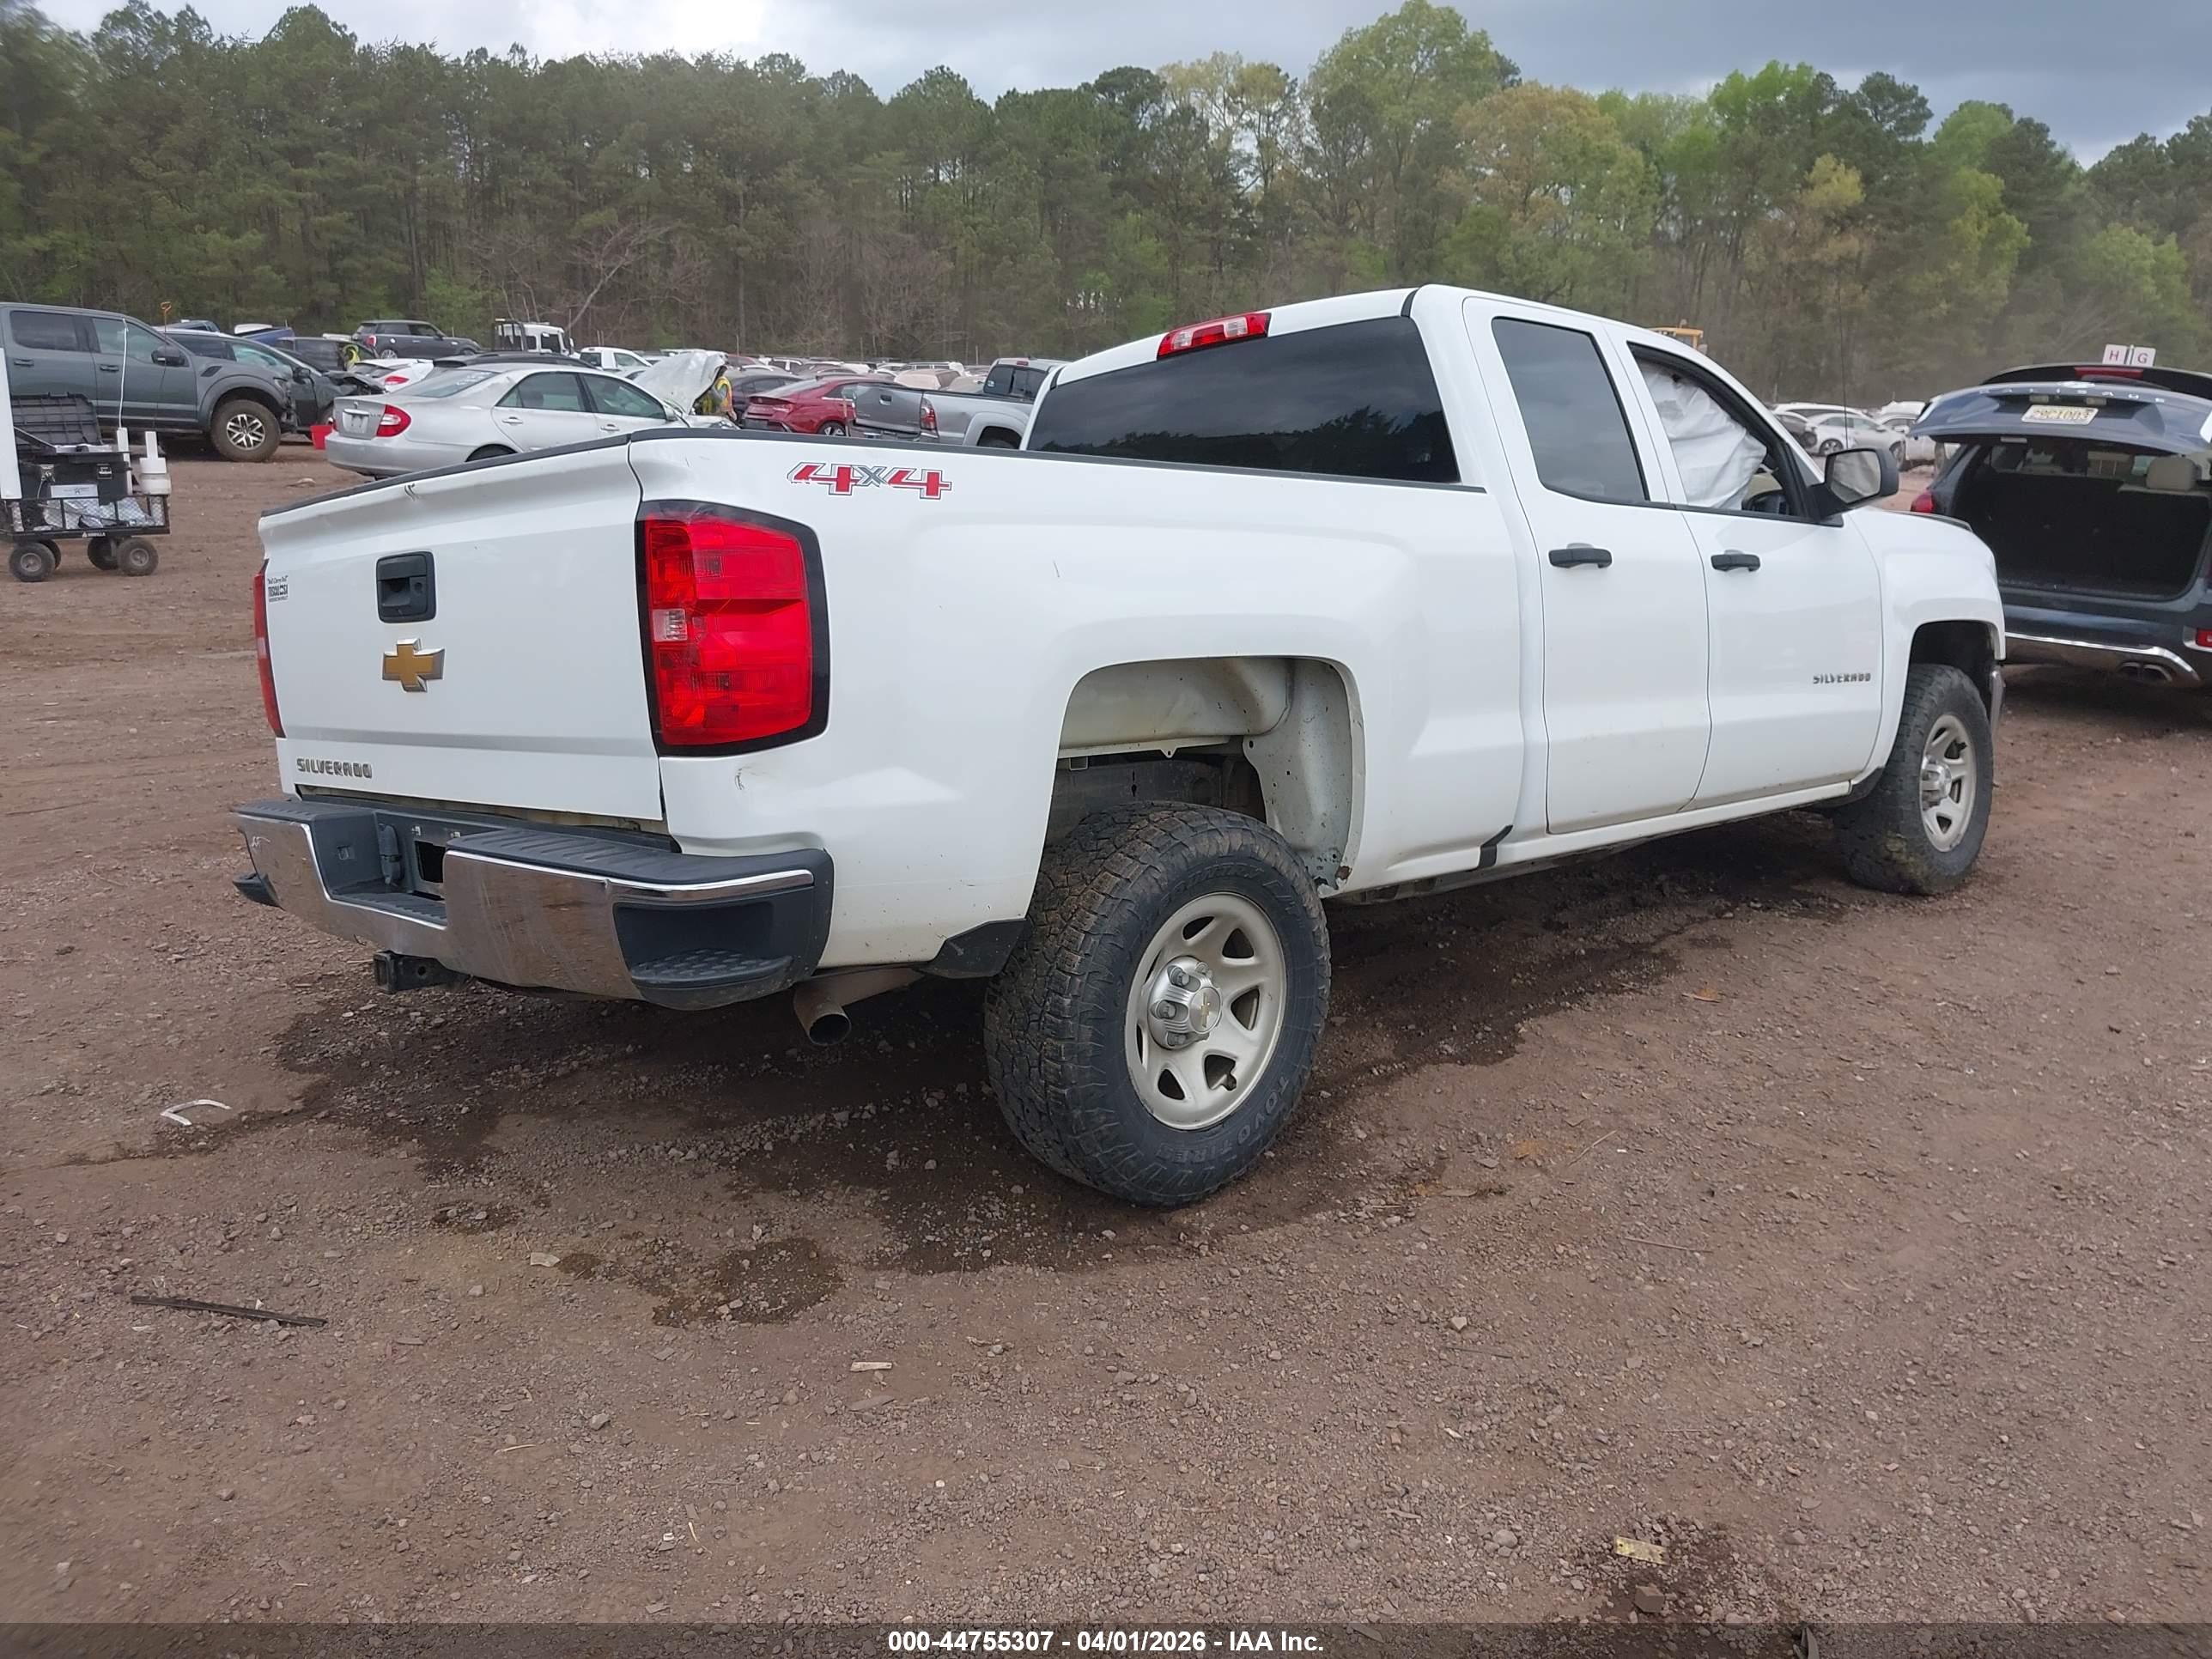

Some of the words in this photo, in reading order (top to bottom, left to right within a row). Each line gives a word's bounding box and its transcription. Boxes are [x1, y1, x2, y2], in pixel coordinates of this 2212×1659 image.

[2109, 350, 2119, 361] H
[2137, 353, 2148, 364] G
[1813, 672, 1871, 684] SILVERADO
[296, 758, 372, 778] SILVERADO
[1237, 1075, 1289, 1146] TOYO
[1155, 1139, 1232, 1164] TIRES
